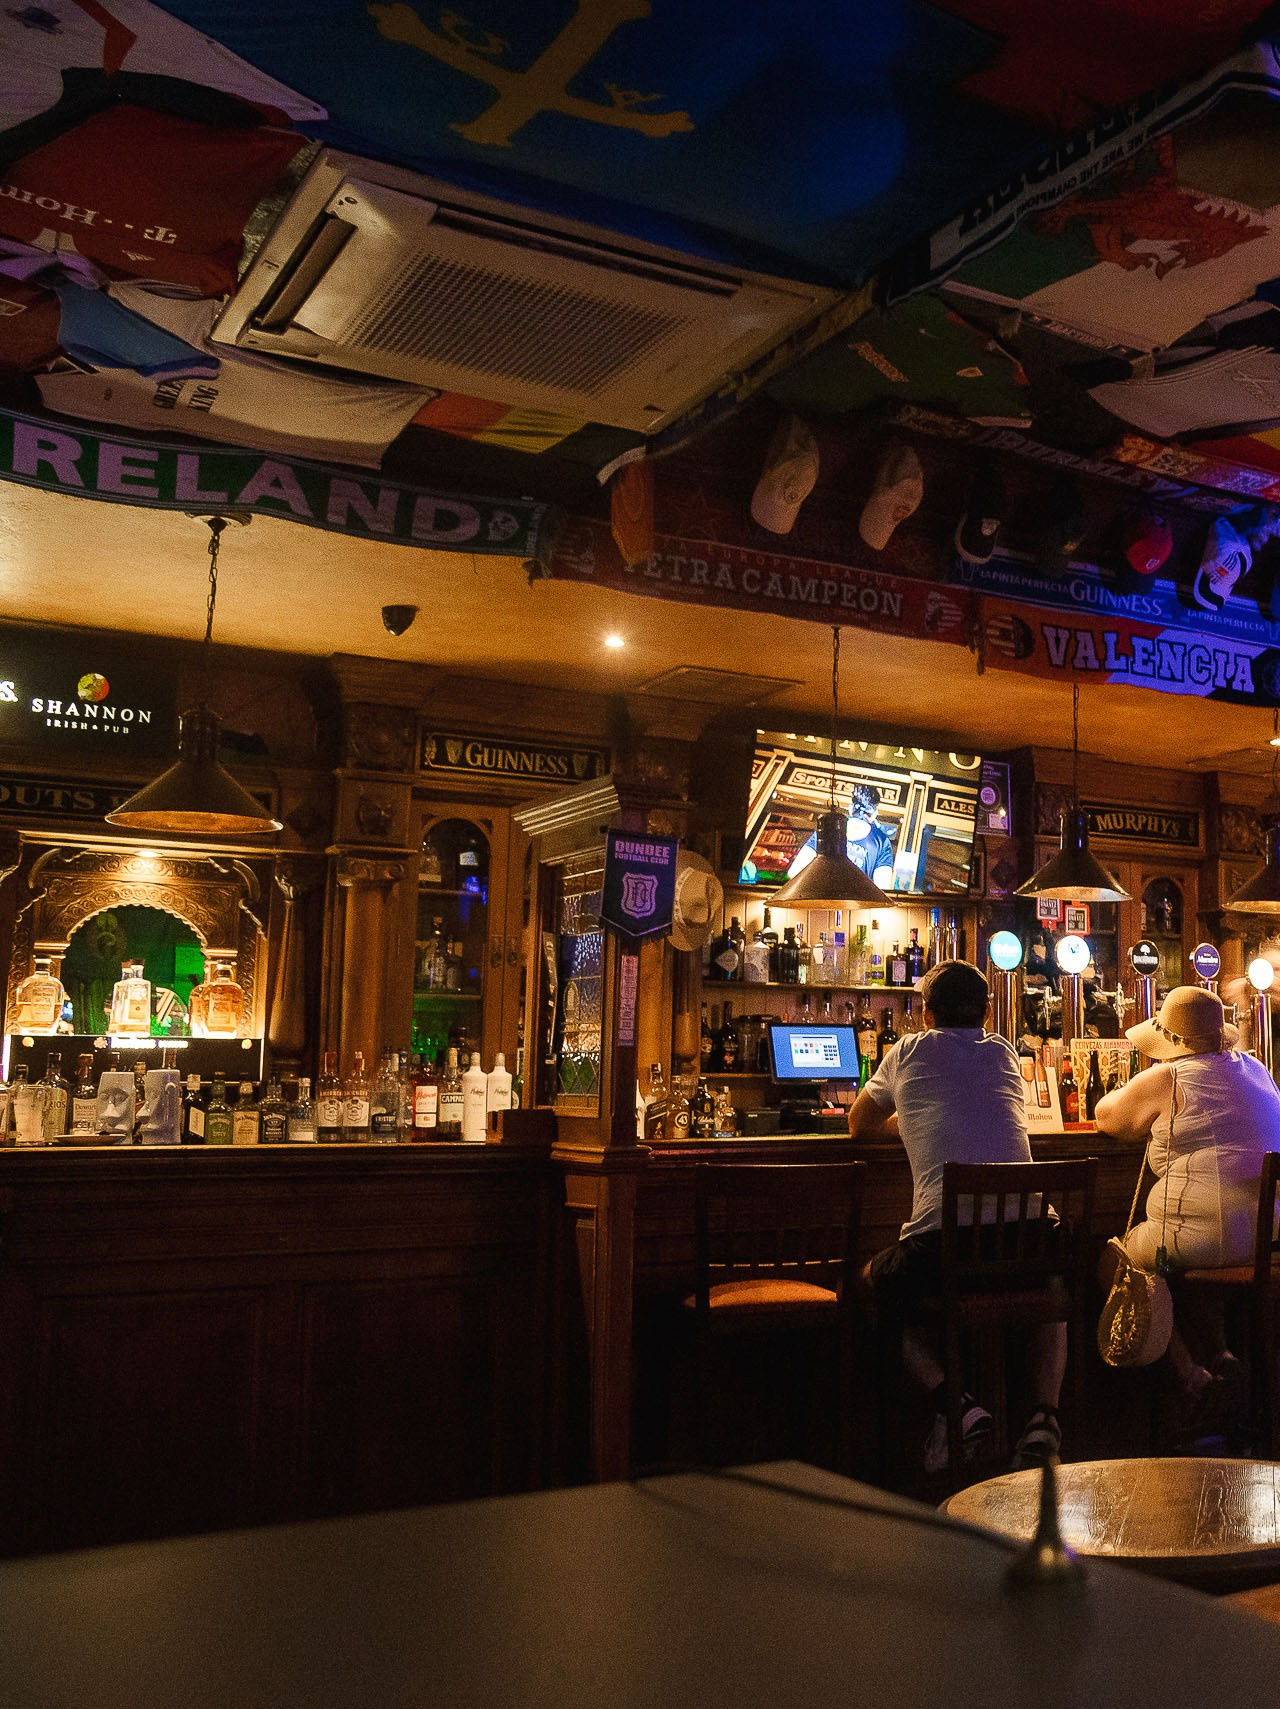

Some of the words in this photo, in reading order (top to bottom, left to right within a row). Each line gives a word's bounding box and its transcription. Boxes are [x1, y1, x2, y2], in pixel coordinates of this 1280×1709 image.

[1070, 578, 1163, 617] GUINNESS
[1040, 622, 1255, 693] VALENCIA
[31, 698, 153, 724] SHANNON
[46, 718, 88, 731] IRISH
[103, 724, 131, 735] PUB
[465, 742, 569, 776] GUINNESS
[793, 771, 855, 793] SPORTS
[878, 783, 897, 802] AR
[940, 800, 975, 815] ALES
[614, 840, 671, 858] DUNDEE
[614, 852, 648, 864] FOOTBALL
[649, 855, 670, 865] CLUB
[1074, 1041, 1103, 1050] CERVEZAS
[676, 1115, 688, 1125] 43
